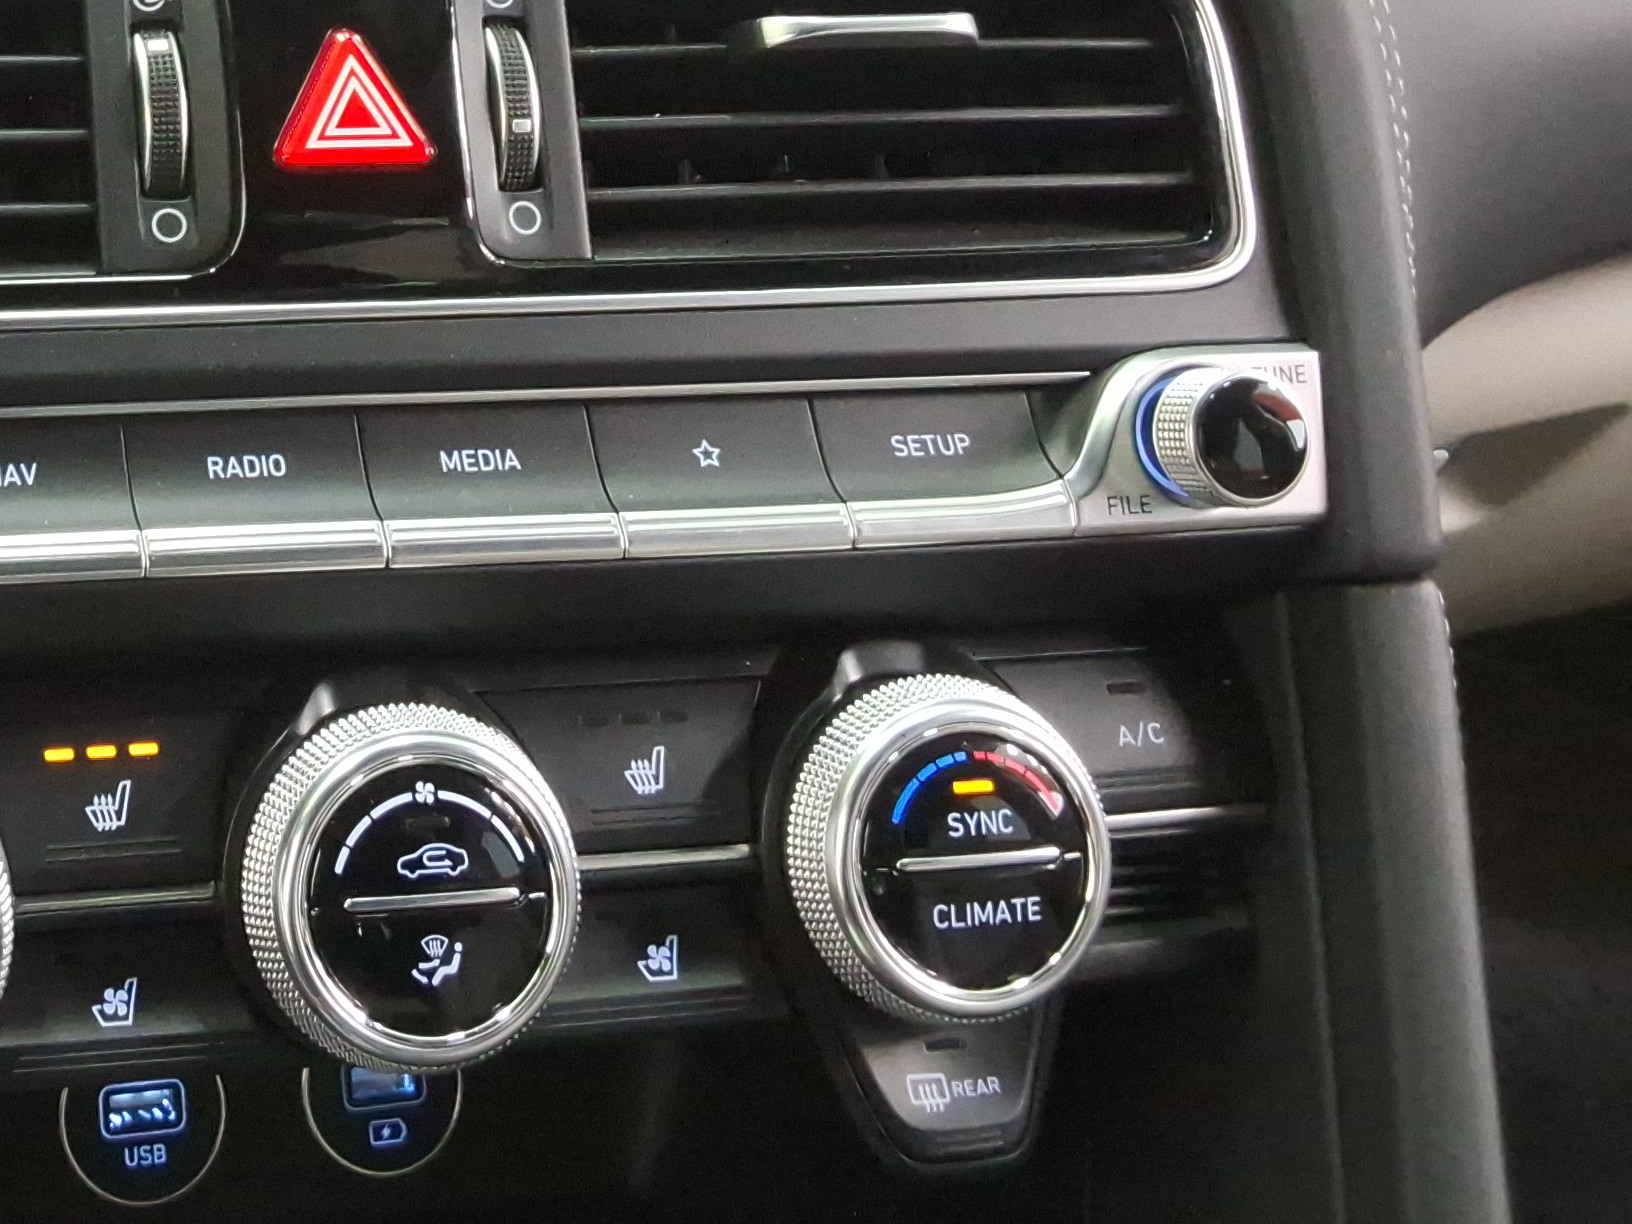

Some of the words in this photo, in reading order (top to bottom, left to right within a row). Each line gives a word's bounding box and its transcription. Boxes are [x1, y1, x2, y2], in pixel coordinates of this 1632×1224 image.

[1250, 363, 1307, 384] NE
[890, 433, 972, 458] SETUP
[206, 453, 288, 480] RADIO
[439, 448, 522, 473] MEDIA
[1106, 494, 1153, 515] FILE
[1118, 721, 1165, 747] A/C
[947, 809, 1014, 839] SYNC
[933, 895, 1042, 930] CLIMATE
[951, 1075, 1001, 1098] REAR
[123, 1143, 167, 1168] USB
